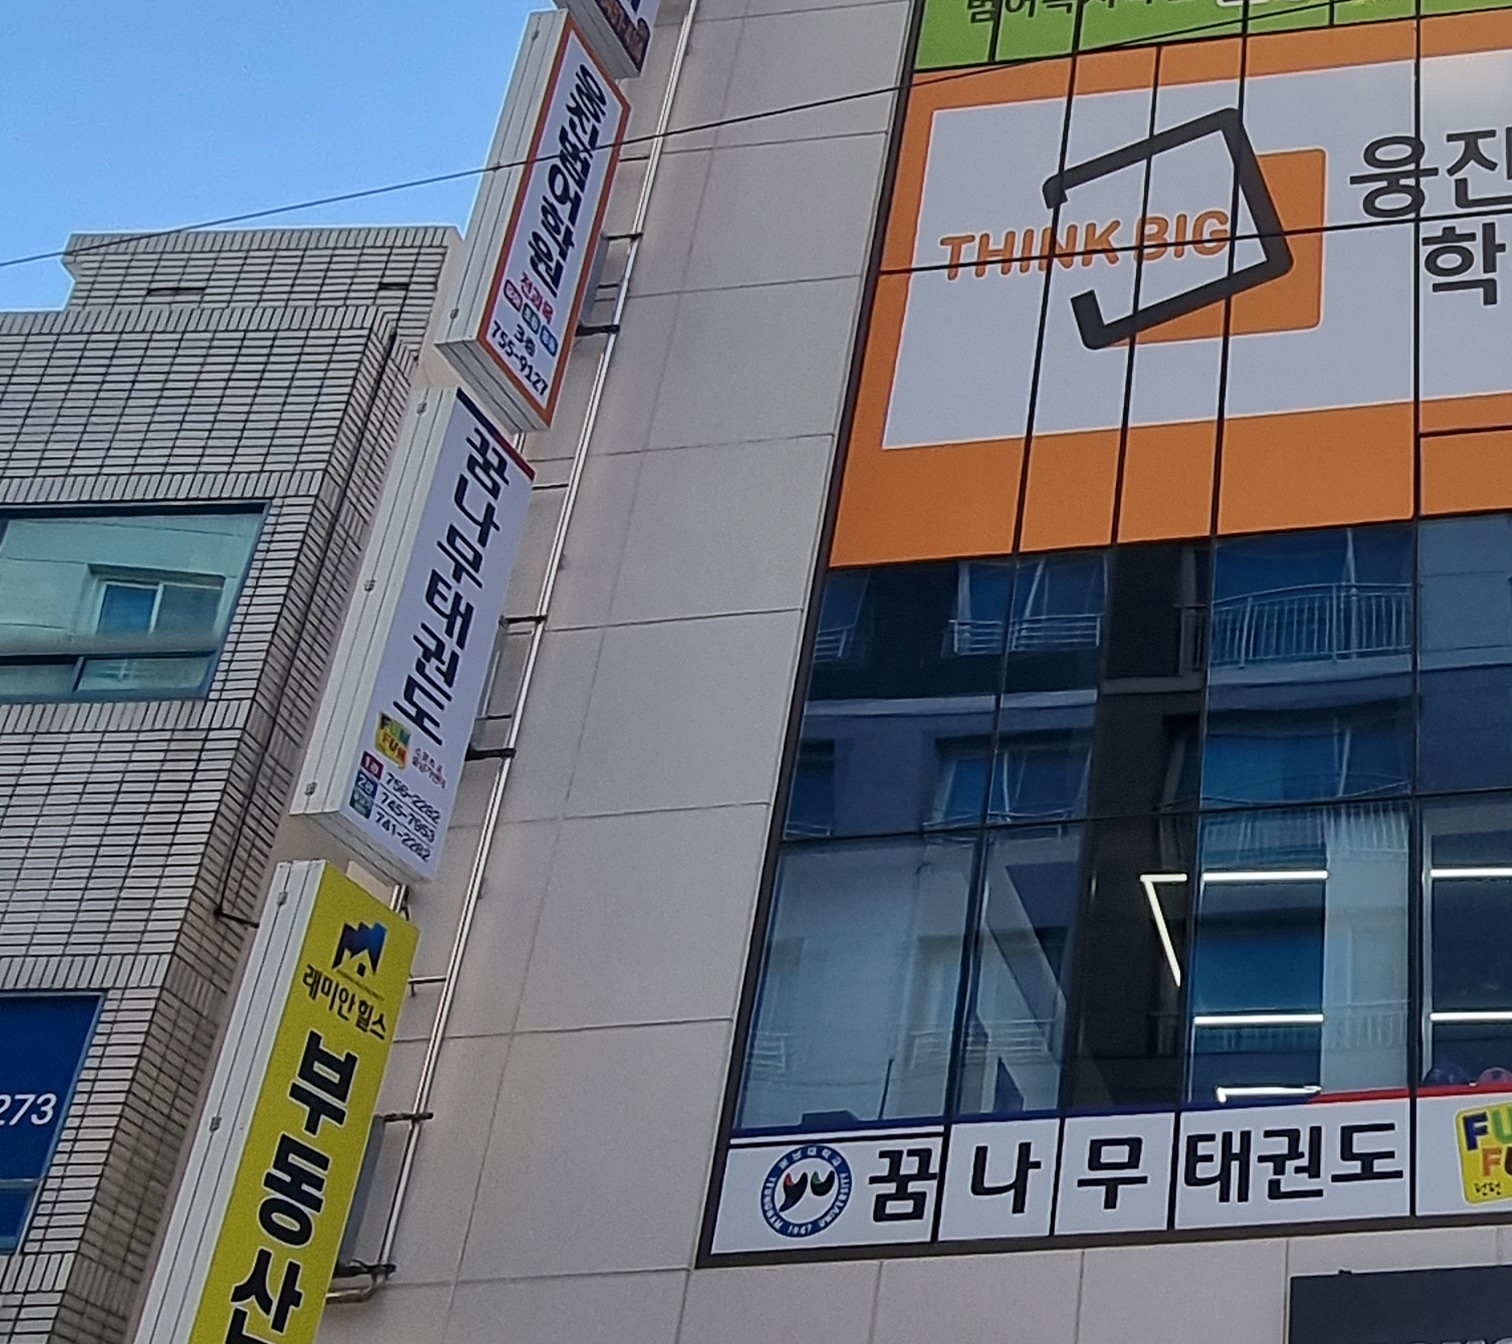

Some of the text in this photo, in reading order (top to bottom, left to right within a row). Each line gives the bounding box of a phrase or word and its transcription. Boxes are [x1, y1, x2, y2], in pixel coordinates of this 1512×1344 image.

[528, 63, 607, 299] 웅진범어학원
[939, 208, 1231, 281] THINK BIG
[489, 320, 550, 396] 755-9127
[393, 427, 510, 746] 꿈나무태권도
